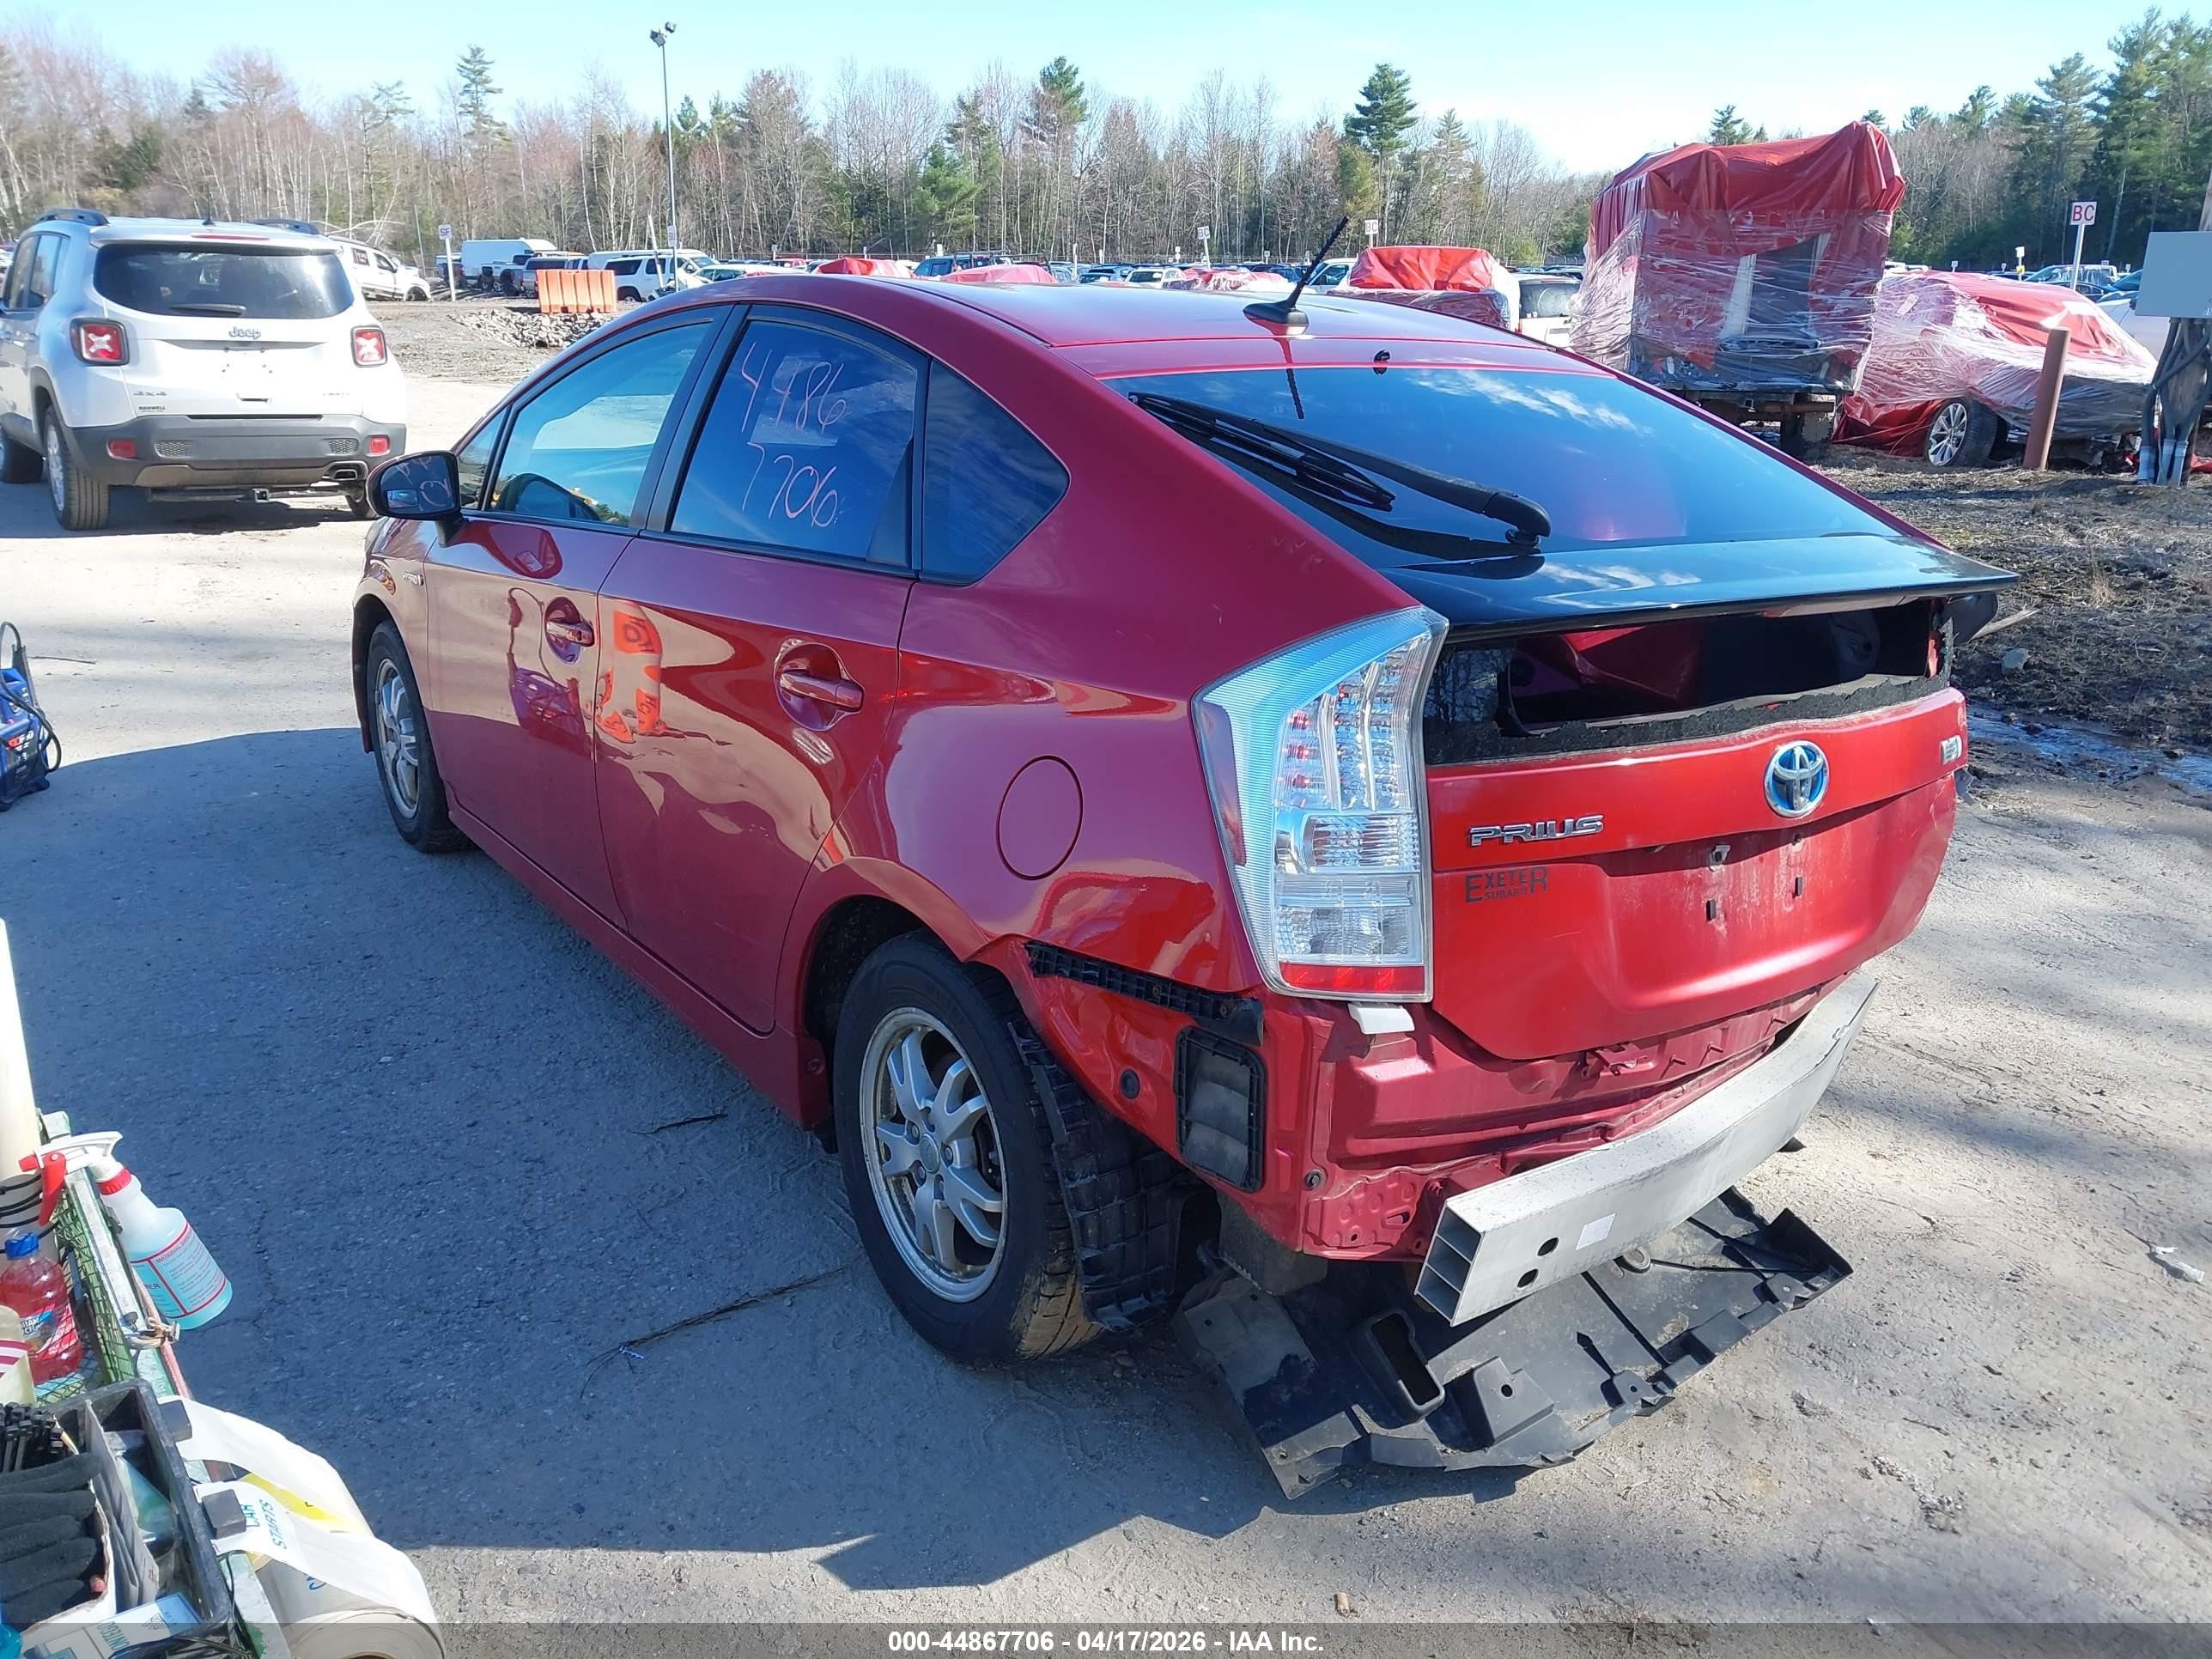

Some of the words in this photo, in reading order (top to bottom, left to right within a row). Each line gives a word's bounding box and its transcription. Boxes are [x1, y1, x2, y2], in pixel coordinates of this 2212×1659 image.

[2072, 205, 2095, 222] BC
[440, 228, 450, 237] SF
[1198, 228, 1209, 238] BC
[1366, 222, 1377, 233] BC
[228, 326, 261, 340] Jeep
[741, 342, 848, 433] 4486
[742, 441, 839, 527] 7706
[1469, 814, 1605, 847] PRIUS
[1465, 865, 1549, 903] EXETER
[258, 1499, 287, 1550] STARTS
